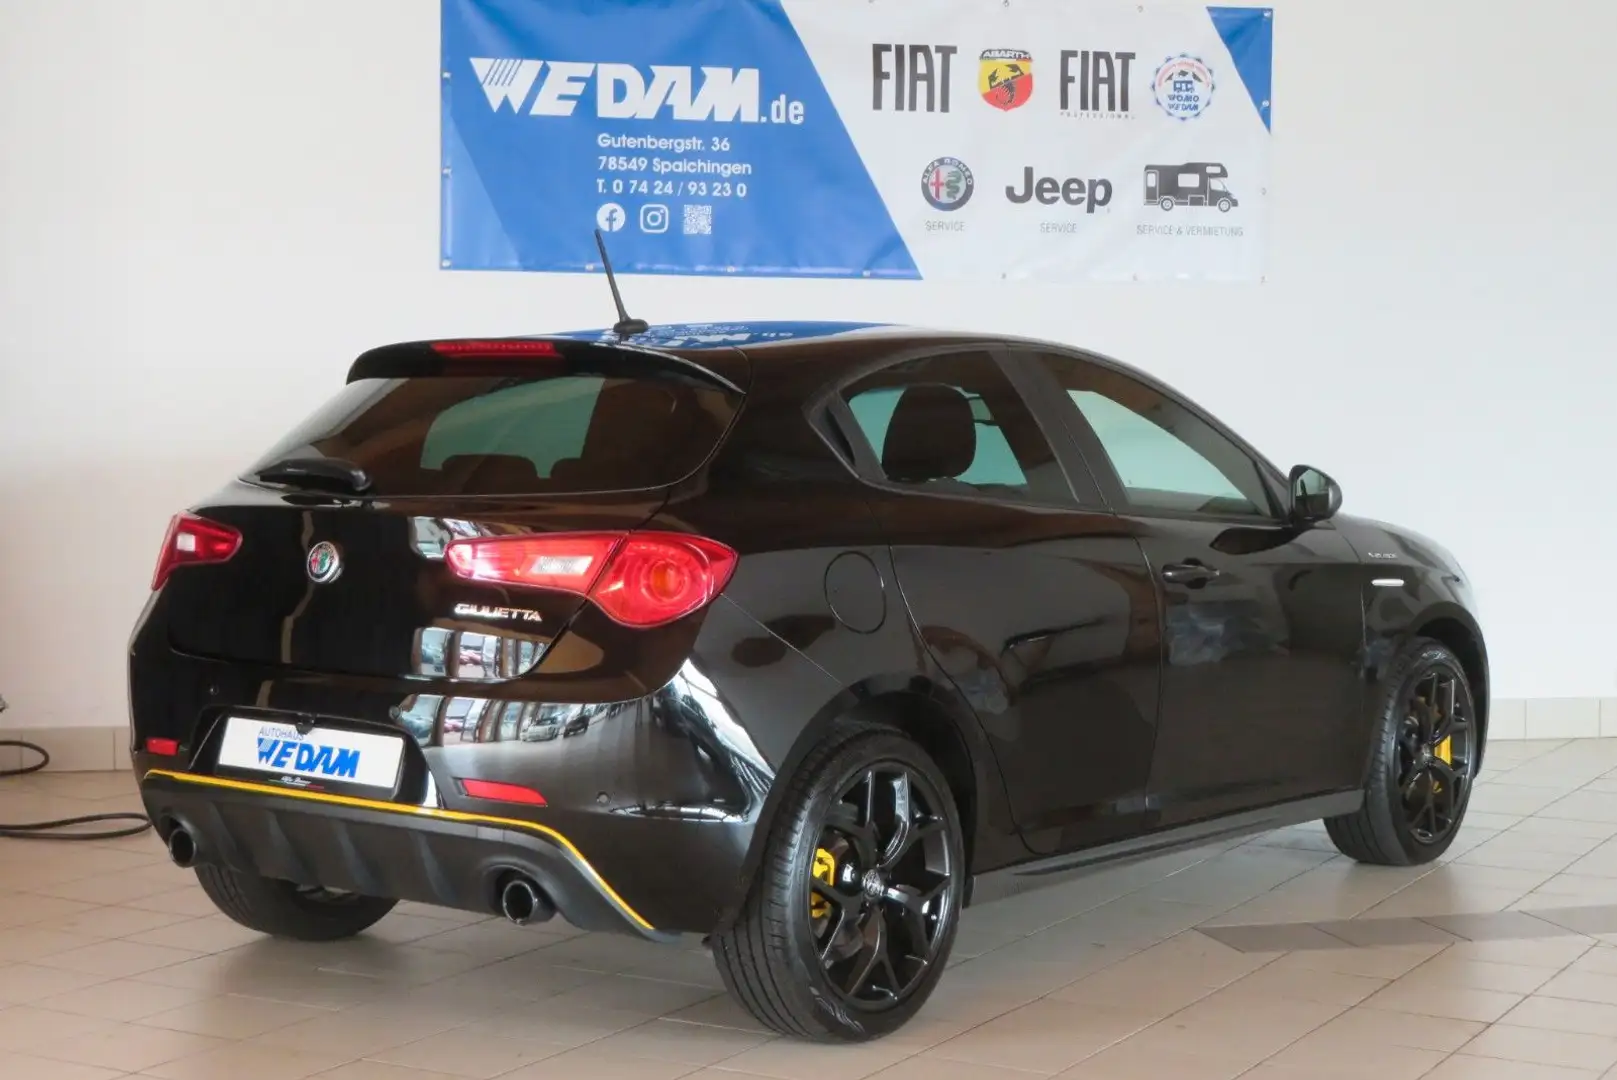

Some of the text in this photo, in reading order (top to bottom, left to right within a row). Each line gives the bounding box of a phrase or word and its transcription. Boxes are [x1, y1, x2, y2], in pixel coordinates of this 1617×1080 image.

[980, 49, 1031, 60] ABARTH
[871, 43, 958, 113] FIAT
[1060, 49, 1136, 112] FIAT
[597, 132, 731, 153] Gutenbergstr. 36
[598, 156, 648, 171] 78549
[596, 178, 607, 193] T.
[612, 179, 623, 194] 0
[629, 179, 648, 194] 74
[653, 180, 673, 195] 24
[688, 181, 707, 196] 93
[712, 182, 731, 197] 23
[736, 183, 747, 197] 0
[1005, 166, 1113, 214] Jeep
[925, 220, 965, 232] SERVICE
[1040, 222, 1077, 234] SERVICE
[1136, 224, 1173, 235] SERVICE
[1186, 225, 1244, 237] VERMIETUNG
[454, 603, 542, 621] GIULIETTA
[259, 726, 304, 741] AUTOHAUS
[257, 737, 361, 778] WEDAM
